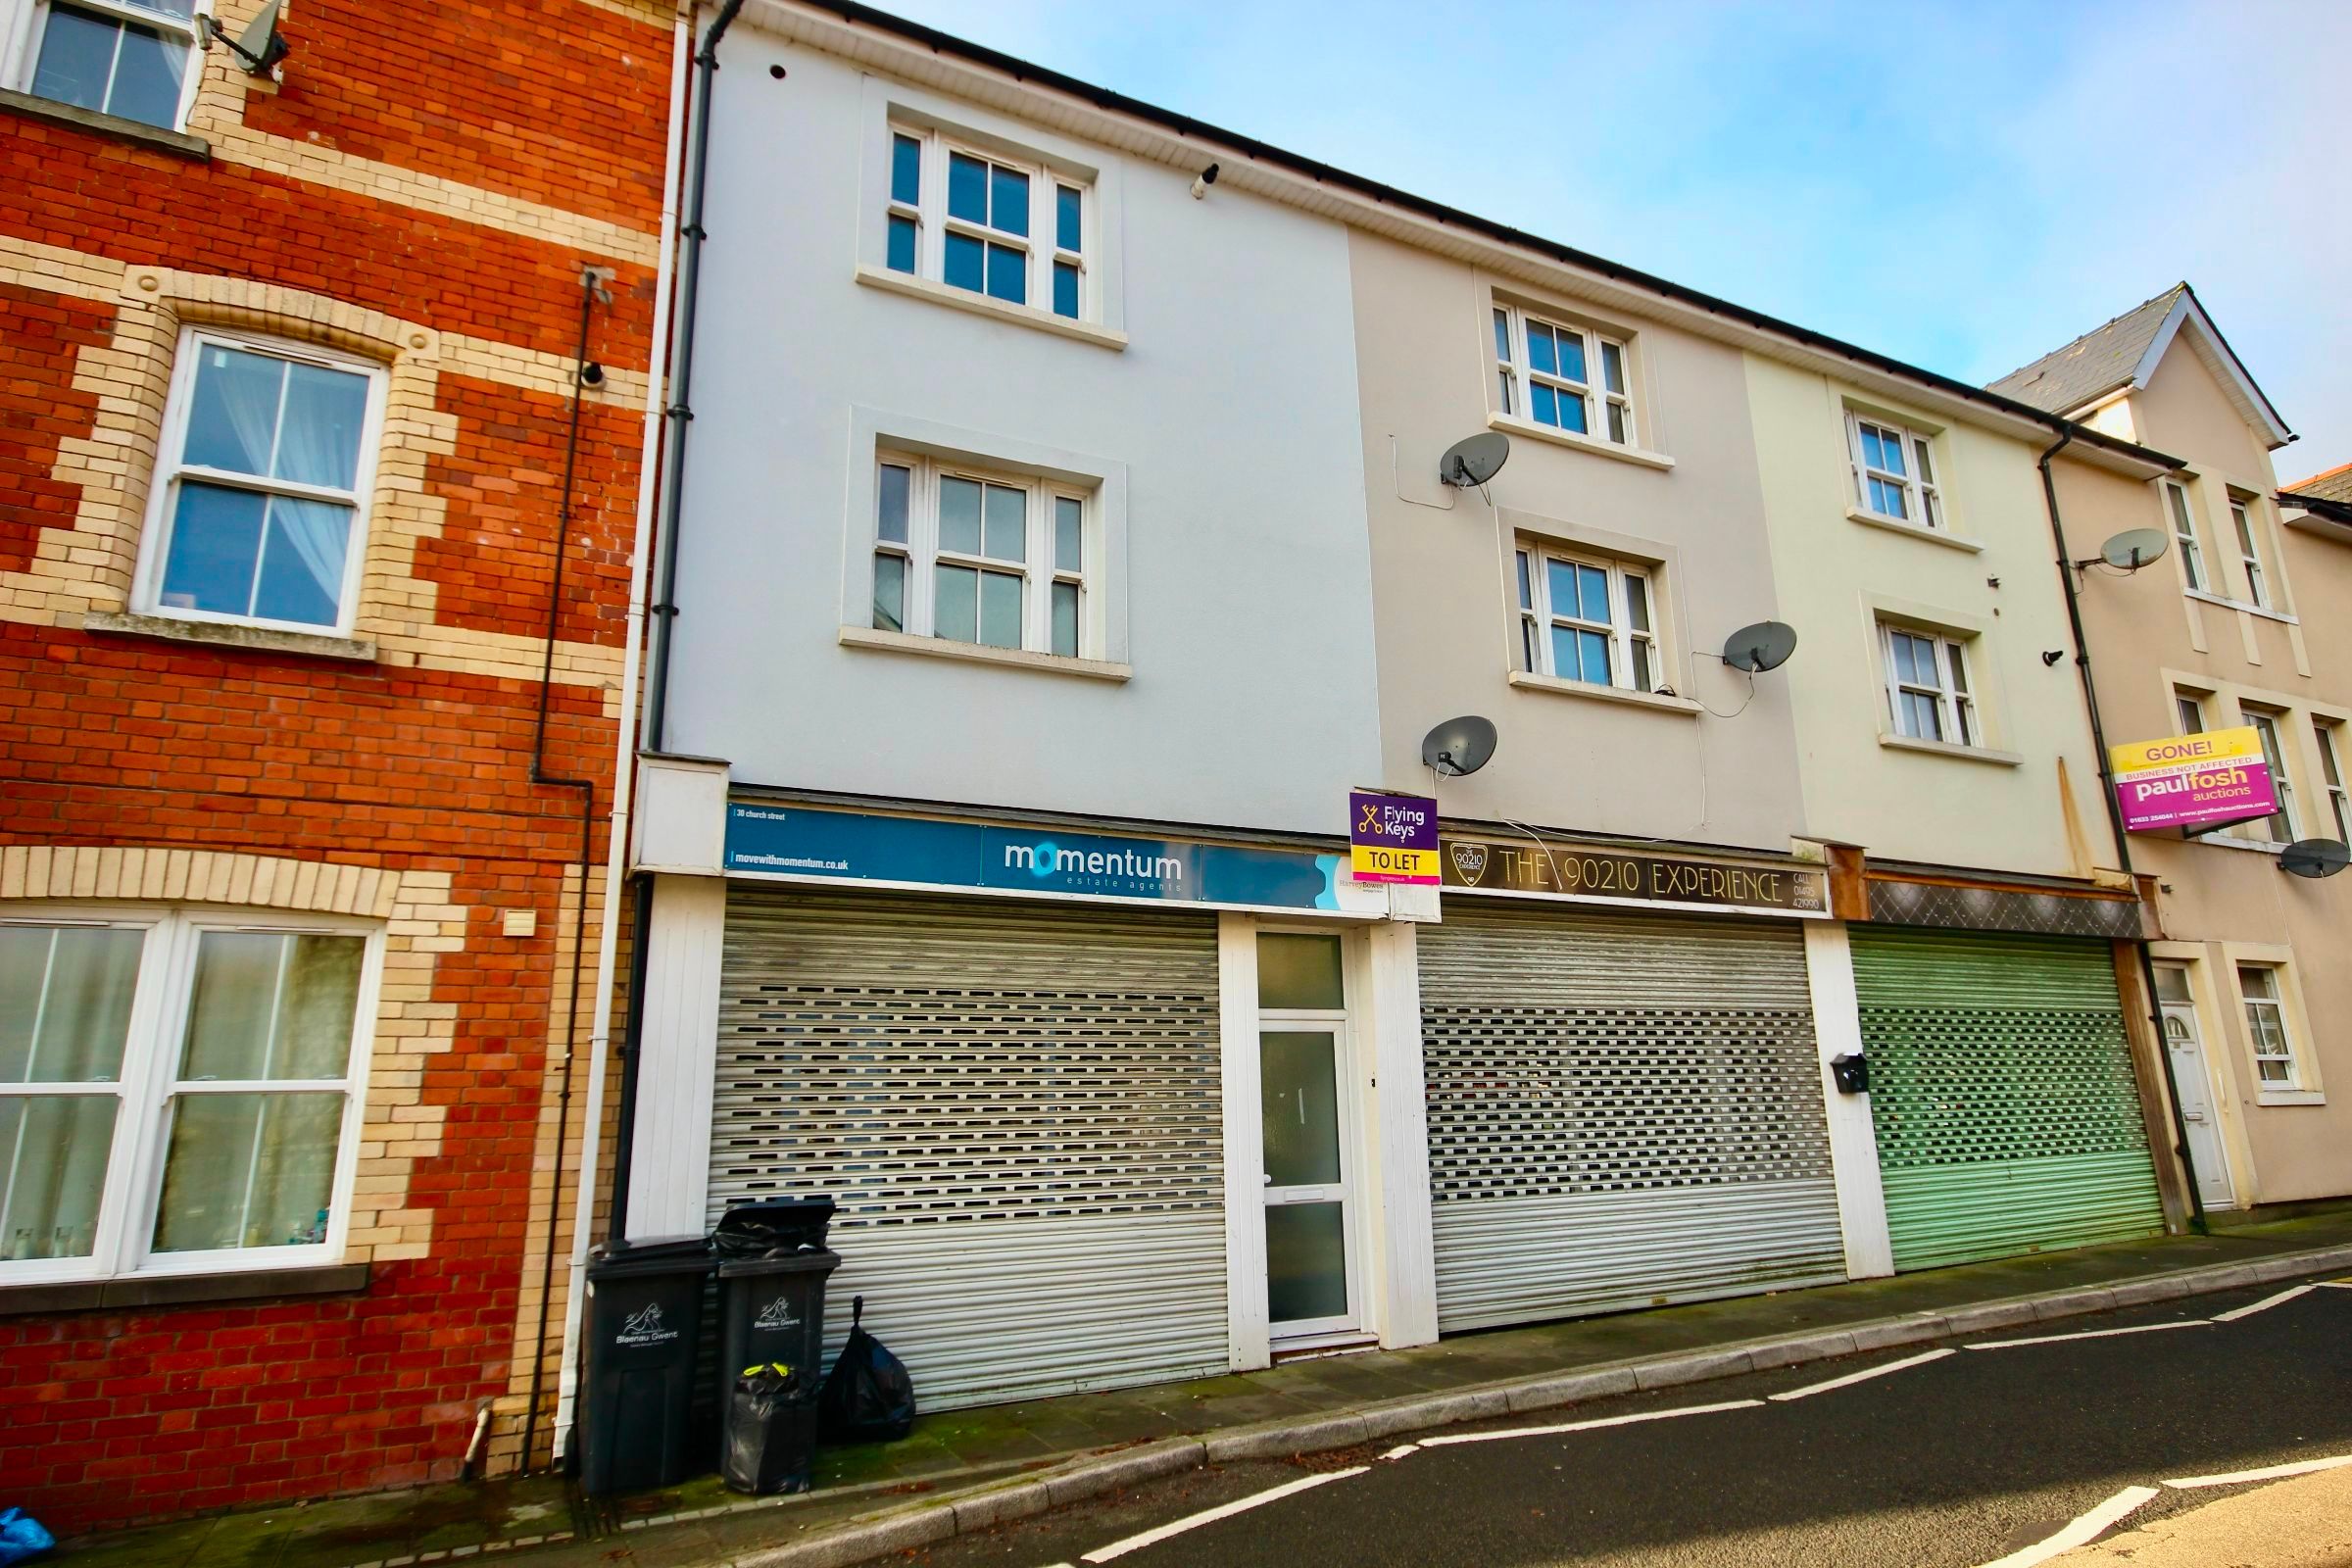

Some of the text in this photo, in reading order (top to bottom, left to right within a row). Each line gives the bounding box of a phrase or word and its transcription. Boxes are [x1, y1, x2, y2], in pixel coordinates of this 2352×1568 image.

[2146, 741, 2213, 760] GONE!
[2126, 757, 2252, 781] BUSINESS NOT AFFECTED
[2193, 787, 2251, 802] auctions
[746, 810, 766, 819] church
[767, 812, 785, 821] street
[1384, 806, 1425, 826] Flying
[1385, 820, 1415, 840] Keys
[735, 854, 849, 870] movewithmomentum.co.uk
[1005, 841, 1182, 880] momentum
[1369, 852, 1420, 870] TO LET
[1455, 853, 1483, 865] 90210
[1066, 877, 1182, 892] estate agents
[1498, 851, 1784, 902] THE 90210 EXPERIENCE
[1792, 898, 1820, 909] 421990
[651, 1332, 678, 1341] Gwent
